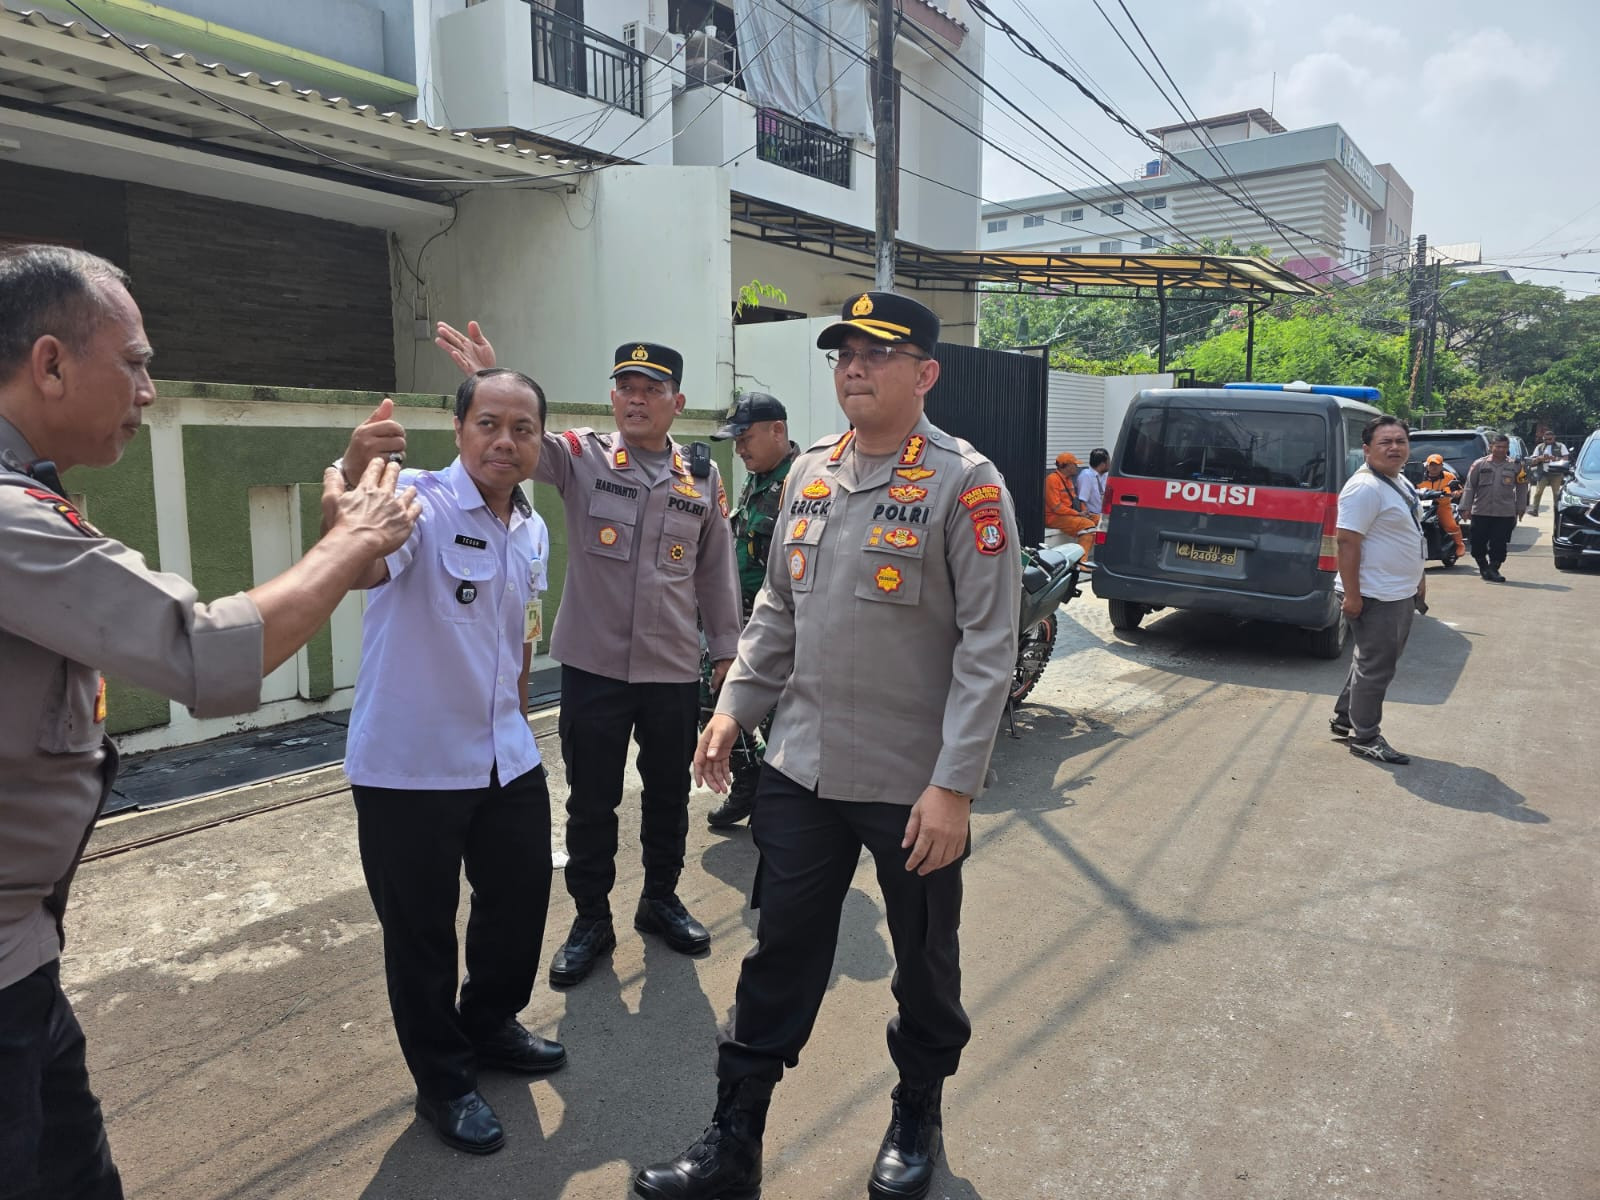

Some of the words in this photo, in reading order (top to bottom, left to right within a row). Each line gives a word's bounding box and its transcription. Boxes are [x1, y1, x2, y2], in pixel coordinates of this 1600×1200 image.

[595, 479, 637, 499] HARIYANTO
[1165, 481, 1256, 506] POLISI
[668, 497, 705, 515] POLRI
[790, 500, 832, 515] ERICK
[872, 504, 930, 524] POLRI
[1193, 551, 1234, 565] 2409-29
